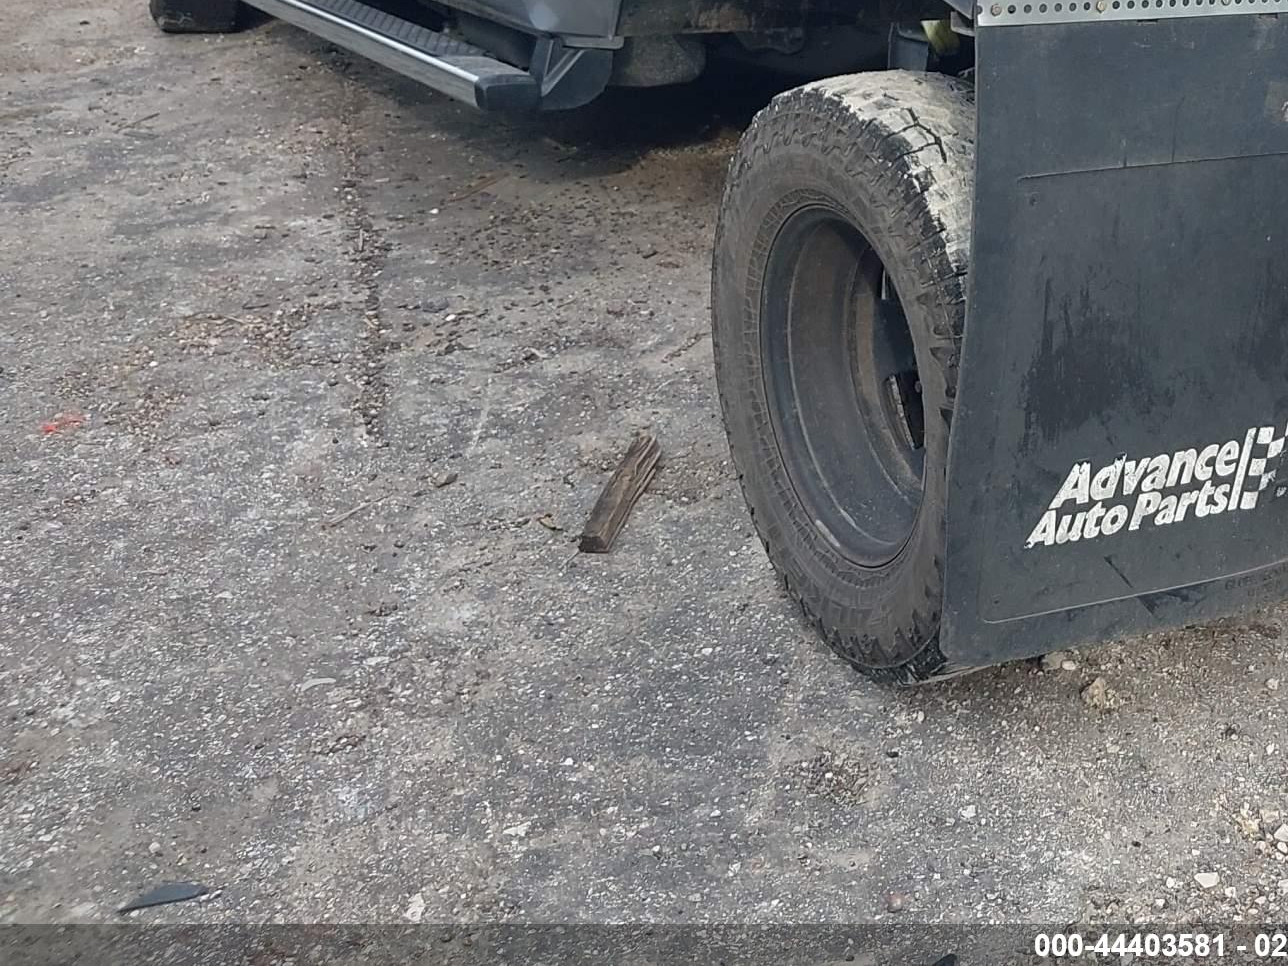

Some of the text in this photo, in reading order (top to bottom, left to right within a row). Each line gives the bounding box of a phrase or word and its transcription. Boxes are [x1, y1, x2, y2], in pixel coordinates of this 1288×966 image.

[1049, 440, 1239, 509] Advance
[1024, 478, 1230, 549] Auto Parts
